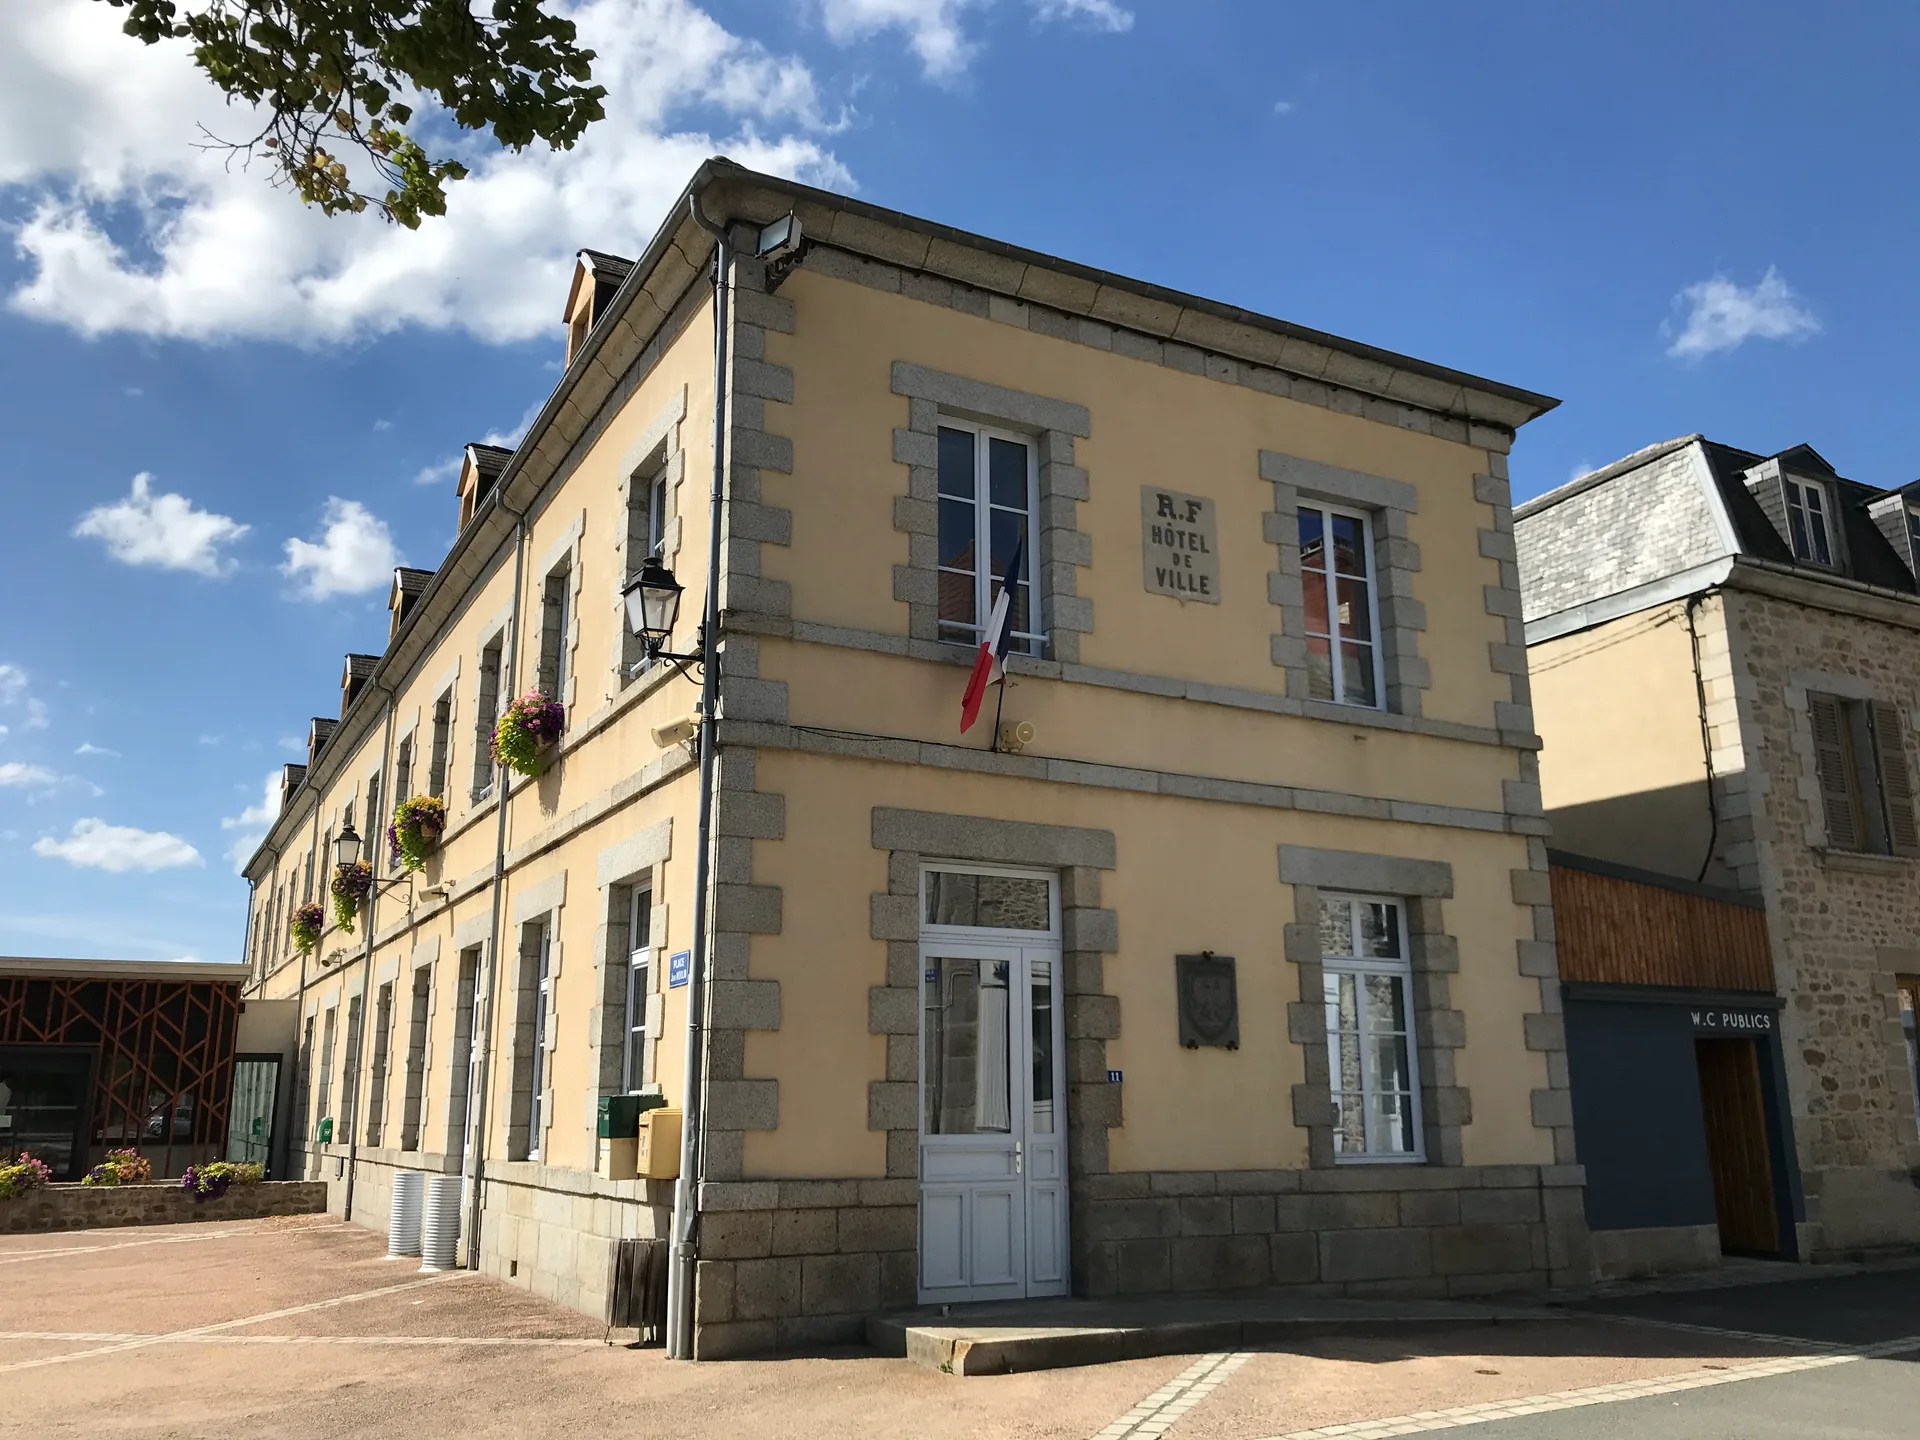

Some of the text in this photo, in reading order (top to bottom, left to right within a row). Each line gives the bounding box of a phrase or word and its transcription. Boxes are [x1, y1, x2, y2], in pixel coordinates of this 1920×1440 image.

[1152, 523, 1210, 554] HÔTEL
[1173, 553, 1192, 568] DE
[1156, 567, 1210, 595] VILLE
[1690, 1012, 1771, 1029] W.C PUBLICS
[1110, 1071, 1120, 1082] 11
